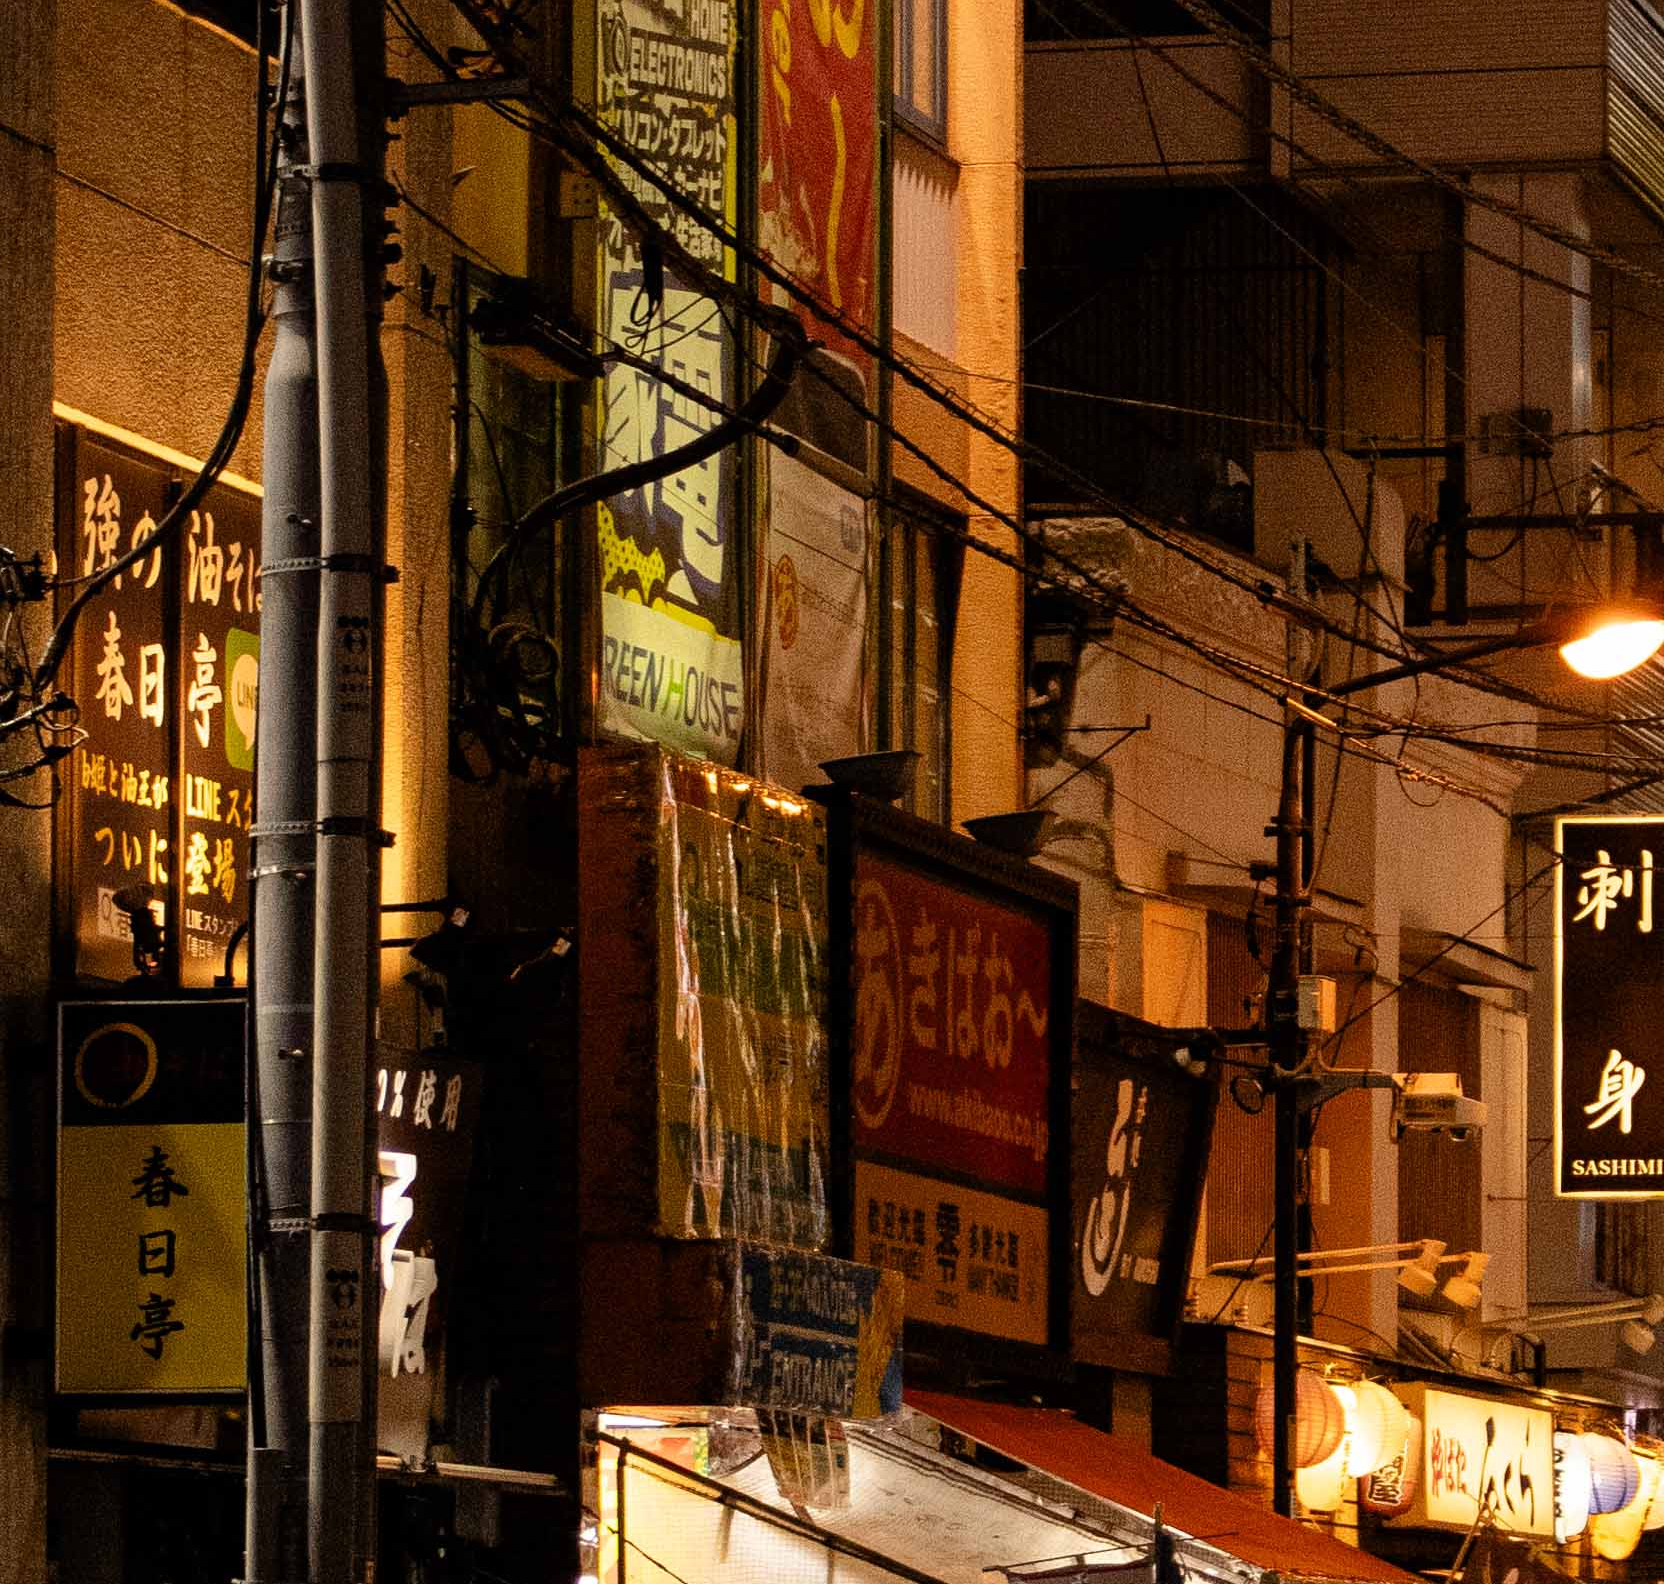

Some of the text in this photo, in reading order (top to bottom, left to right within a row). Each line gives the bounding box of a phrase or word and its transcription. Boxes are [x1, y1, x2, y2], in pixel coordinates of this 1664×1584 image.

[630, 35, 727, 100] ELECTRONICS
[96, 609, 223, 749] 春日亭
[663, 655, 740, 739] HOUSE
[1572, 848, 1655, 1136] 刺身
[1572, 1156, 1664, 1177] SASHIMI
[130, 1146, 189, 1360] 春日亭
